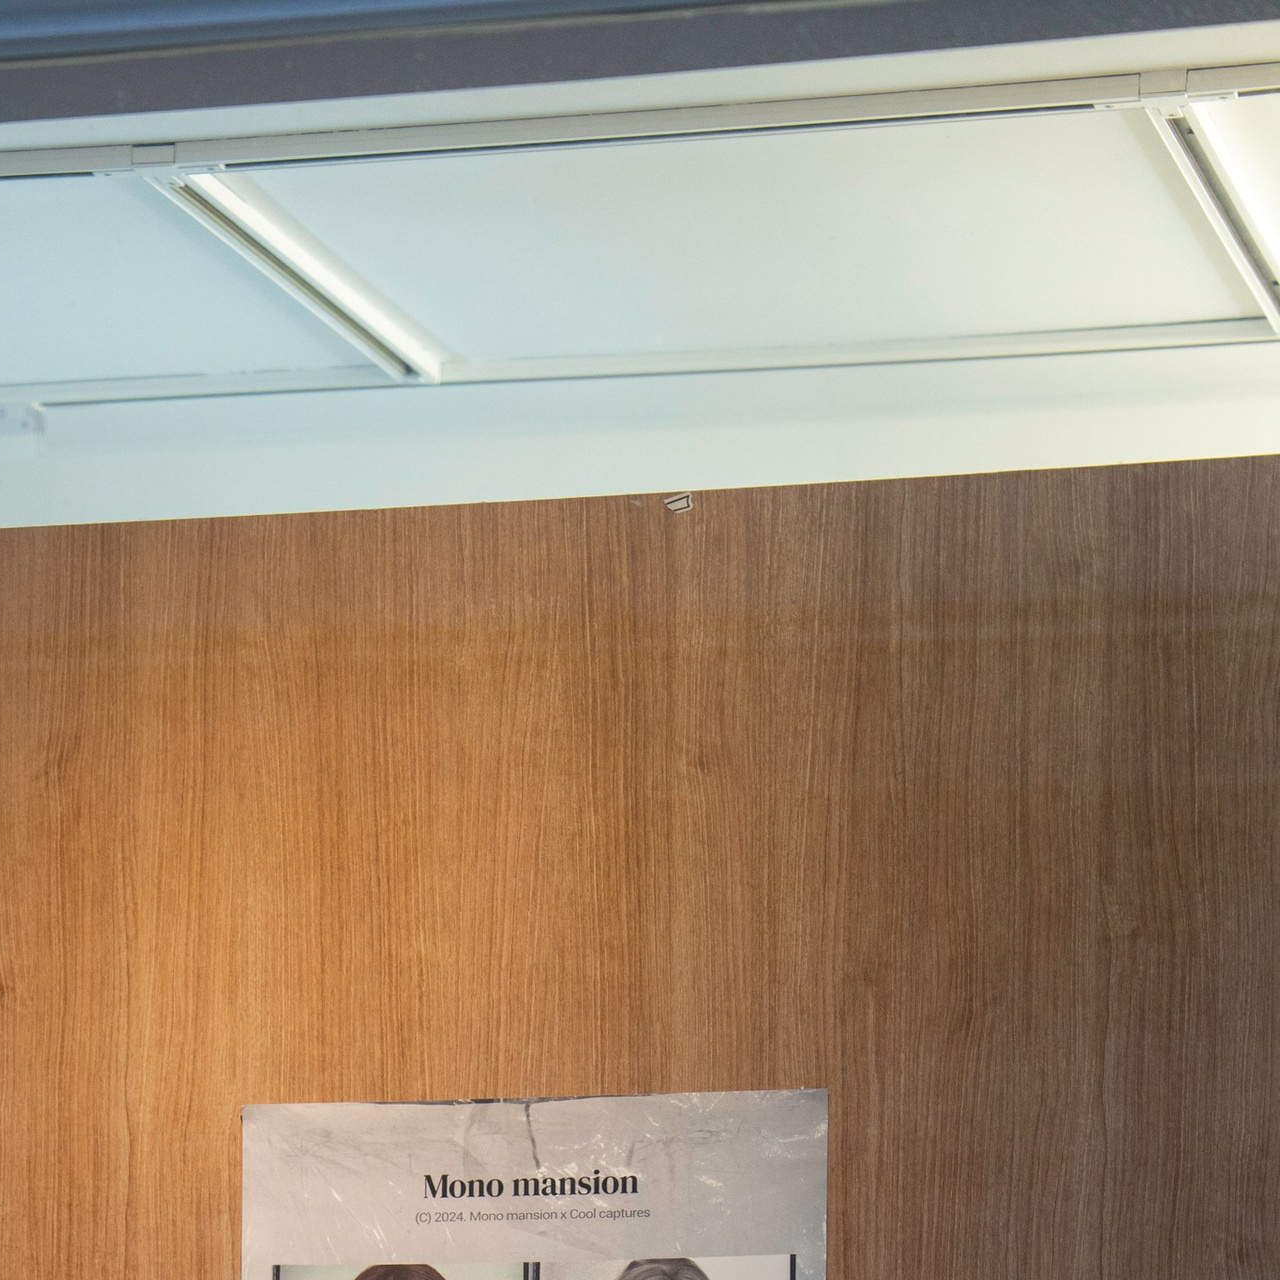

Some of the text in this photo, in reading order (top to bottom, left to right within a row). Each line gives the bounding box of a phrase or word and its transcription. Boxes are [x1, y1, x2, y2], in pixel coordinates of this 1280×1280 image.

[423, 1169, 639, 1199] Mono mansion
[415, 1208, 651, 1225] (C) 2024. Mono mansion x Cool captures
